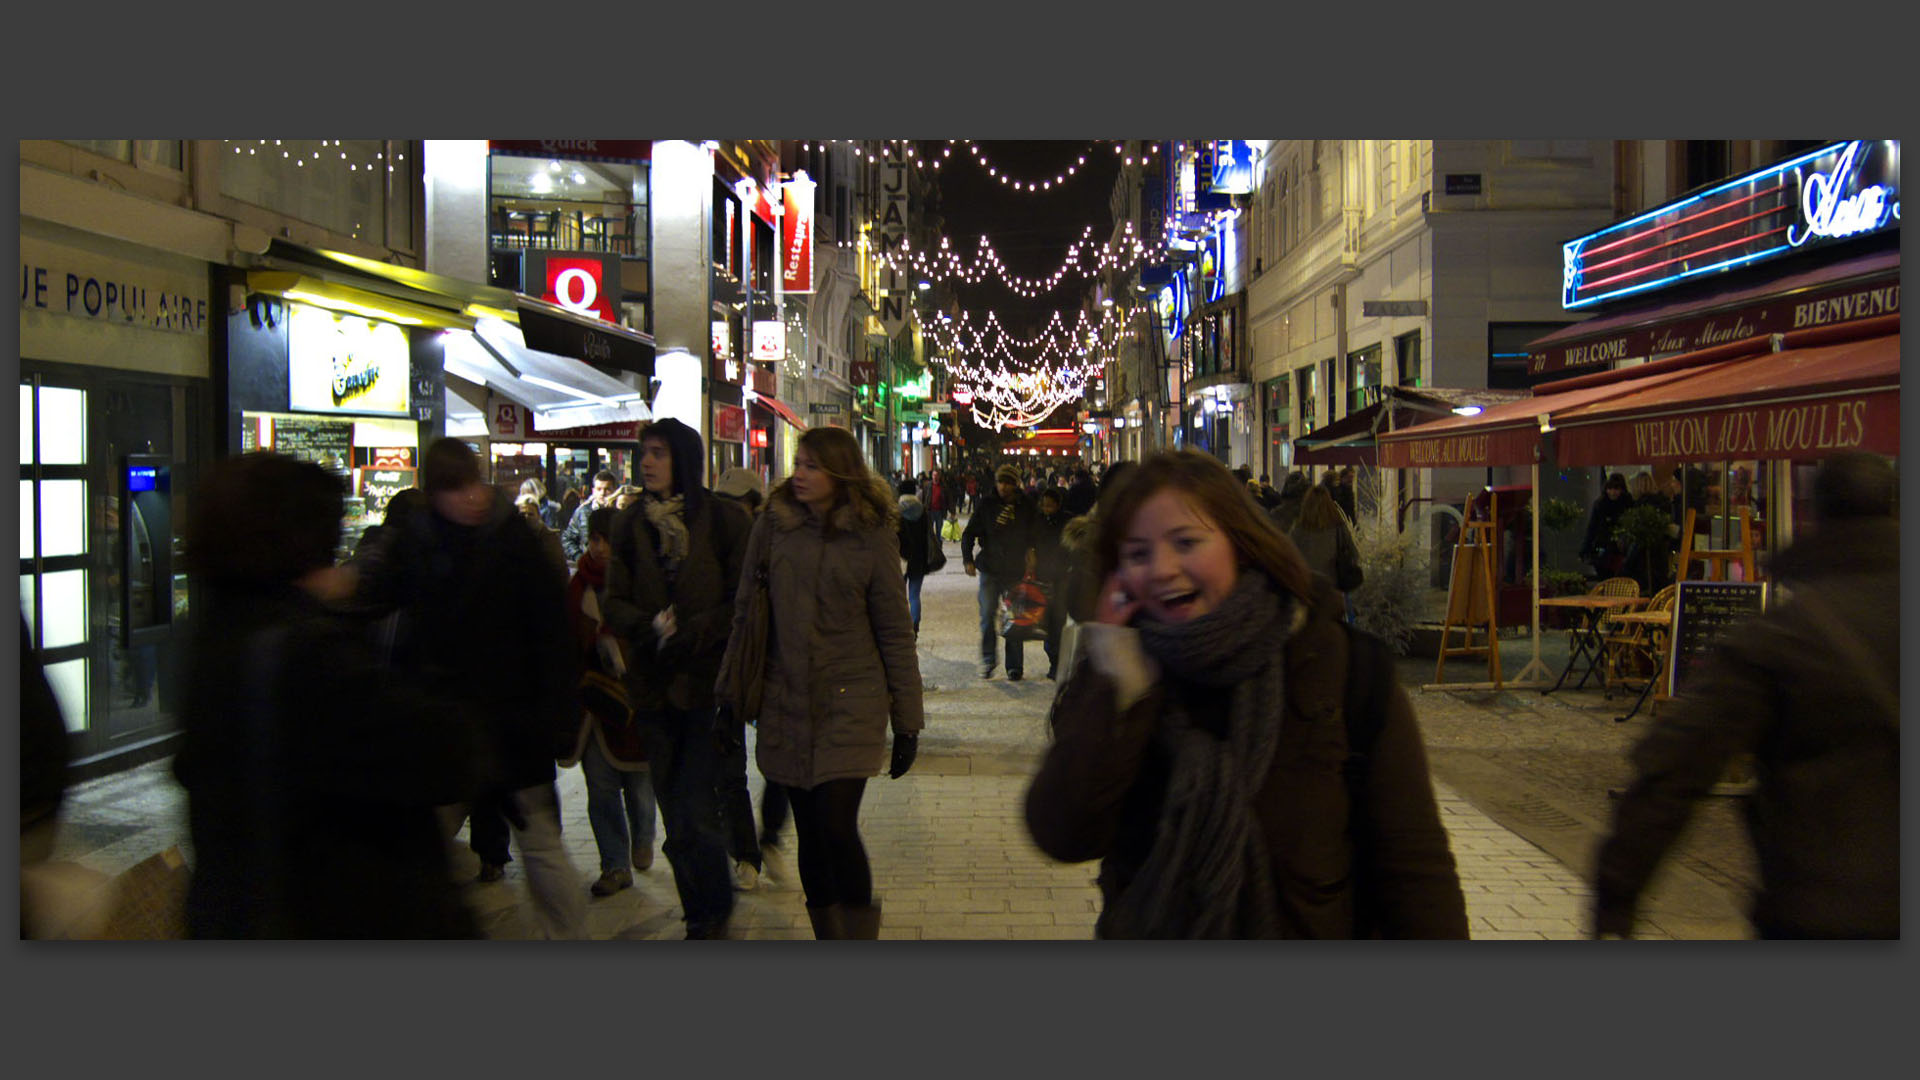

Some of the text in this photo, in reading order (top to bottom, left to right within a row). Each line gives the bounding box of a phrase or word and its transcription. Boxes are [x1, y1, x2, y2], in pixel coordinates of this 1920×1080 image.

[66, 272, 207, 331] POPULAIRE
[555, 267, 601, 320] Q
[1564, 338, 1628, 367] WELCOME
[1793, 286, 1900, 328] BIENVENU
[1633, 399, 1867, 457] WELKOM AUX MOULES
